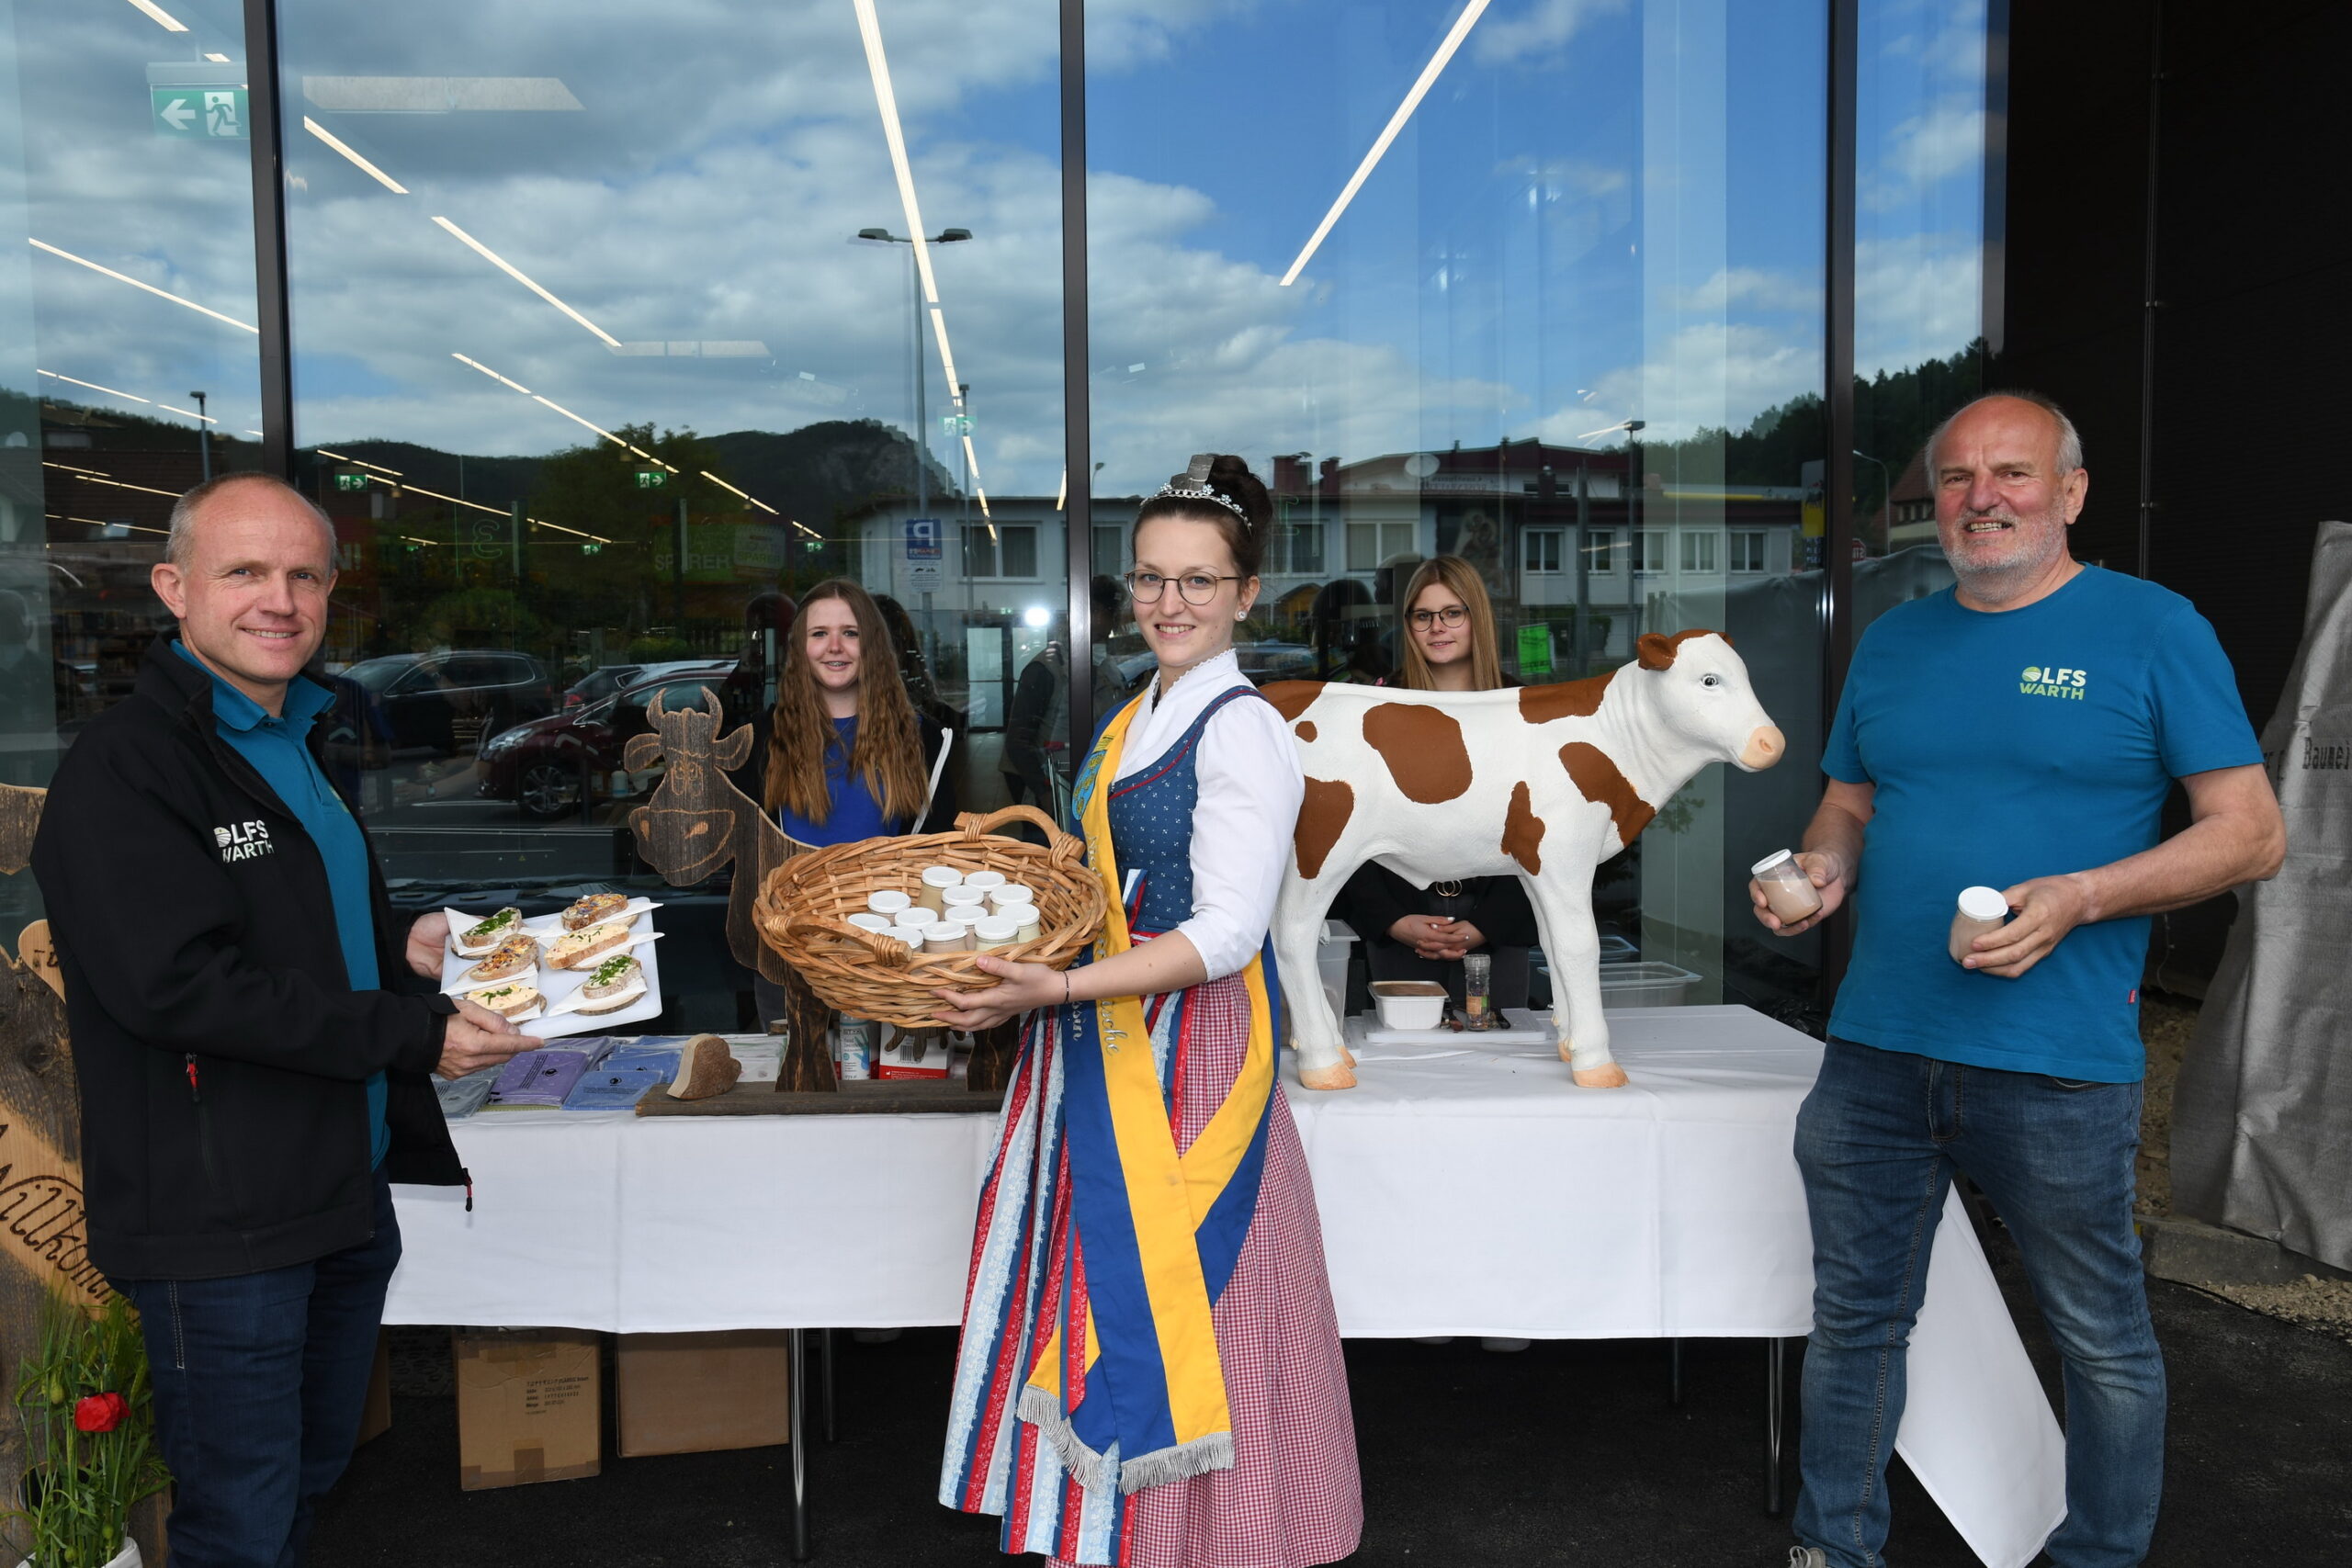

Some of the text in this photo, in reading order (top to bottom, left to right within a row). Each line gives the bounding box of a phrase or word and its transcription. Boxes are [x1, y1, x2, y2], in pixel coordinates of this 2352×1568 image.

[654, 553, 729, 571] SPRER
[2041, 667, 2087, 687] LFS
[2019, 682, 2086, 701] WARTH
[231, 819, 269, 844] LFS
[222, 839, 275, 863] WARTH
